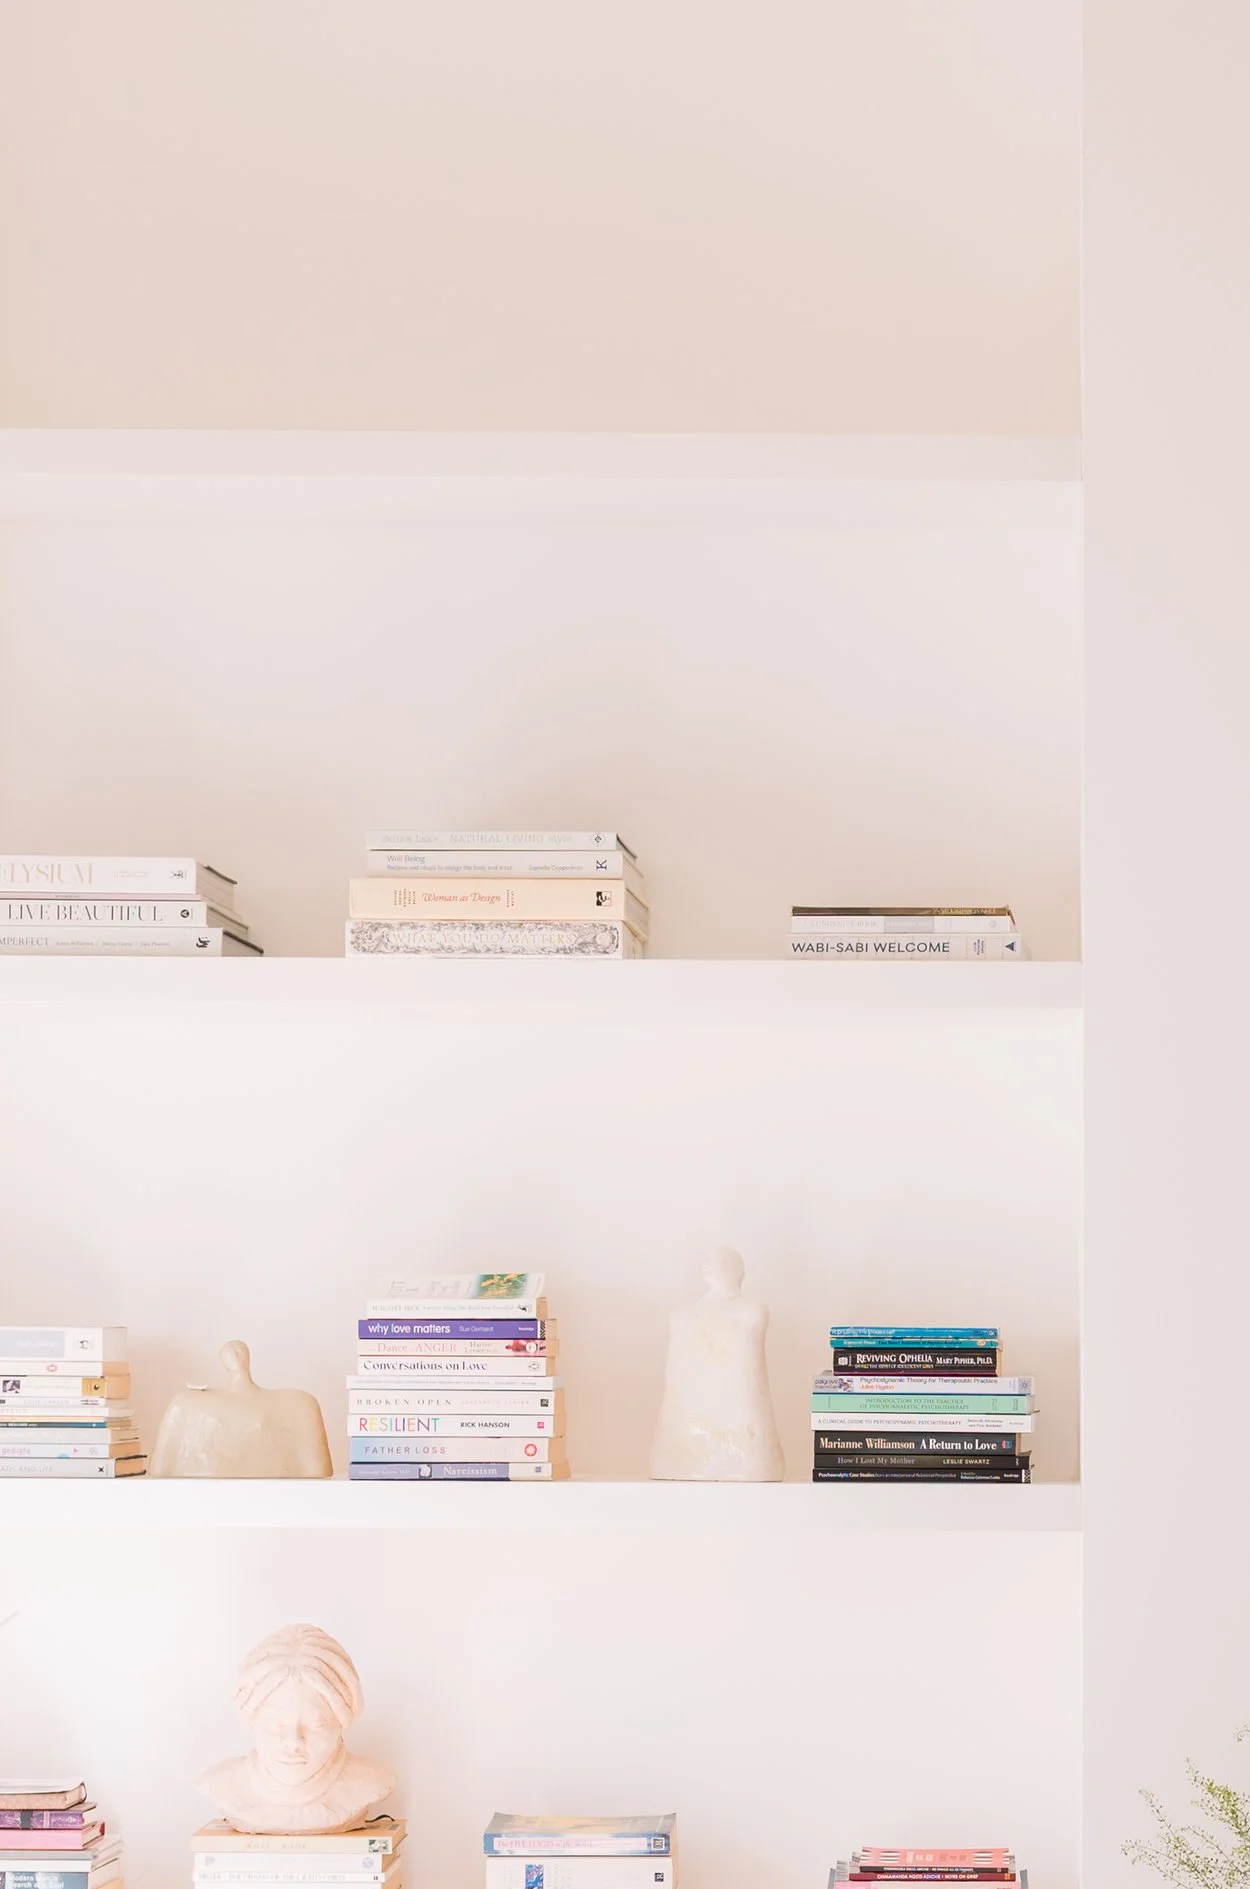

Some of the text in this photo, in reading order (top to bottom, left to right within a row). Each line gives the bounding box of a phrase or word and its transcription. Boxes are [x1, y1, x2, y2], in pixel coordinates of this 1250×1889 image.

[450, 834, 502, 844] NATURAL
[507, 834, 543, 844] LIVING
[387, 855, 425, 863] Well Being
[422, 891, 458, 904] Woman
[470, 891, 501, 904] Design
[9, 904, 51, 921] LIVE
[56, 904, 164, 921] BEAUTIFUL
[392, 932, 433, 945] WHAT
[479, 932, 500, 945] DO
[508, 932, 575, 945] MATTERS
[792, 942, 950, 953] WABI-SABI WELCOME
[368, 1323, 451, 1336] why love matters
[377, 1343, 458, 1353] Dance ANGER
[856, 1353, 933, 1363] REVIVING OPHELIA
[363, 1360, 488, 1371] Conversations on Love
[860, 1377, 904, 1385] Psychodynamic
[907, 1377, 927, 1385] Theory
[928, 1377, 937, 1385] for
[973, 1377, 998, 1385] Practice
[357, 1398, 452, 1406] BROKEN OPEN
[359, 1417, 440, 1432] RESILIENT
[819, 1436, 997, 1451] Marianne Williamson A Return to Love
[364, 1446, 411, 1455] FATHER
[415, 1446, 446, 1455] LOSS
[837, 1456, 853, 1466] How
[860, 1456, 876, 1466] Lost
[877, 1456, 888, 1466] My
[889, 1456, 915, 1466] Mother
[443, 1465, 498, 1476] Narcissism
